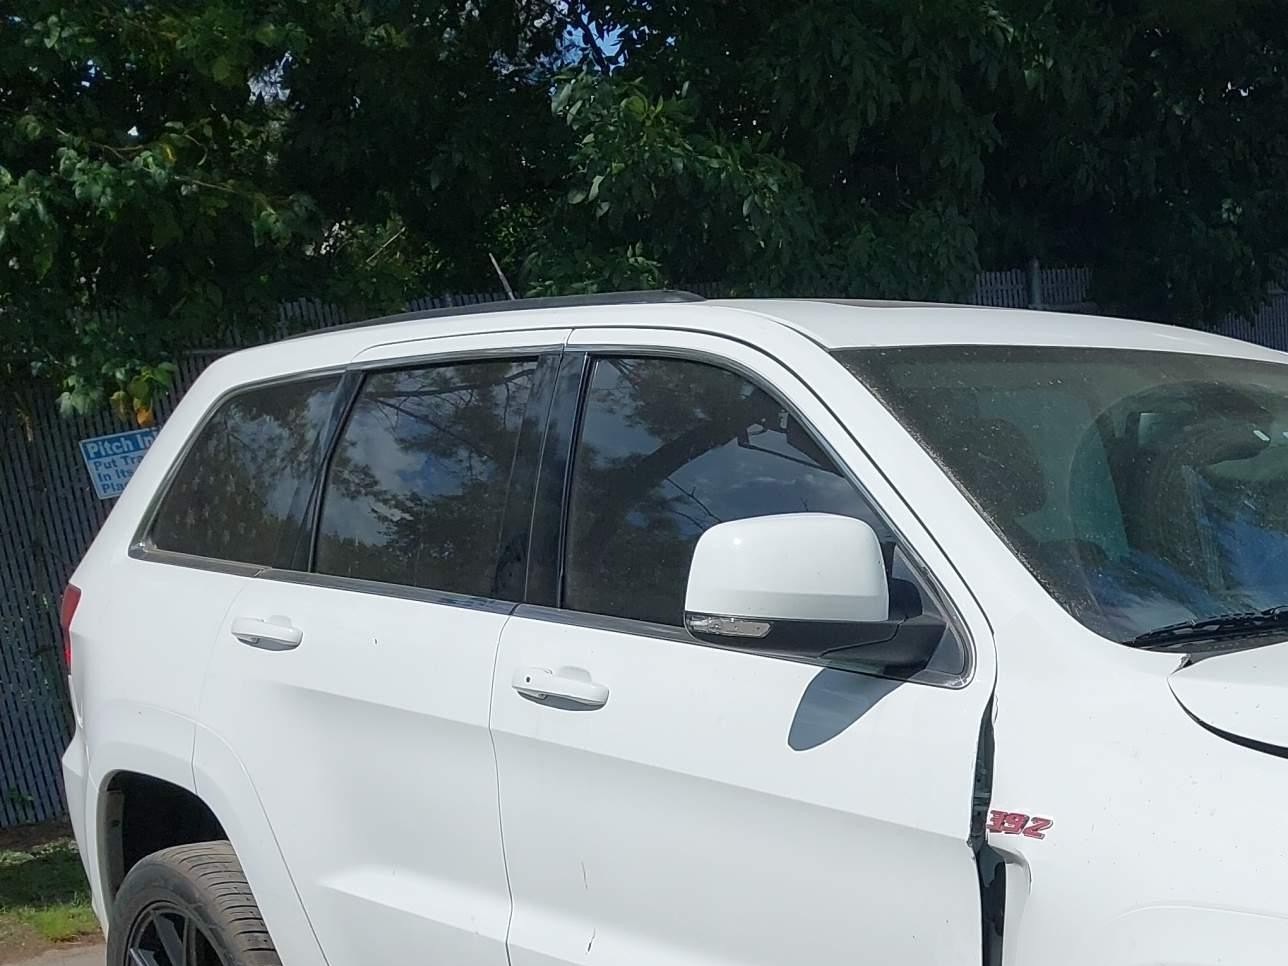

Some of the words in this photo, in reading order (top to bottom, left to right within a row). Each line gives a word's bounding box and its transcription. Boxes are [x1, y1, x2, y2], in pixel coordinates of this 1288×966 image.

[86, 437, 134, 458] Pitch
[93, 458, 118, 471] Put
[97, 472, 112, 482] In
[986, 809, 1054, 840] 392
